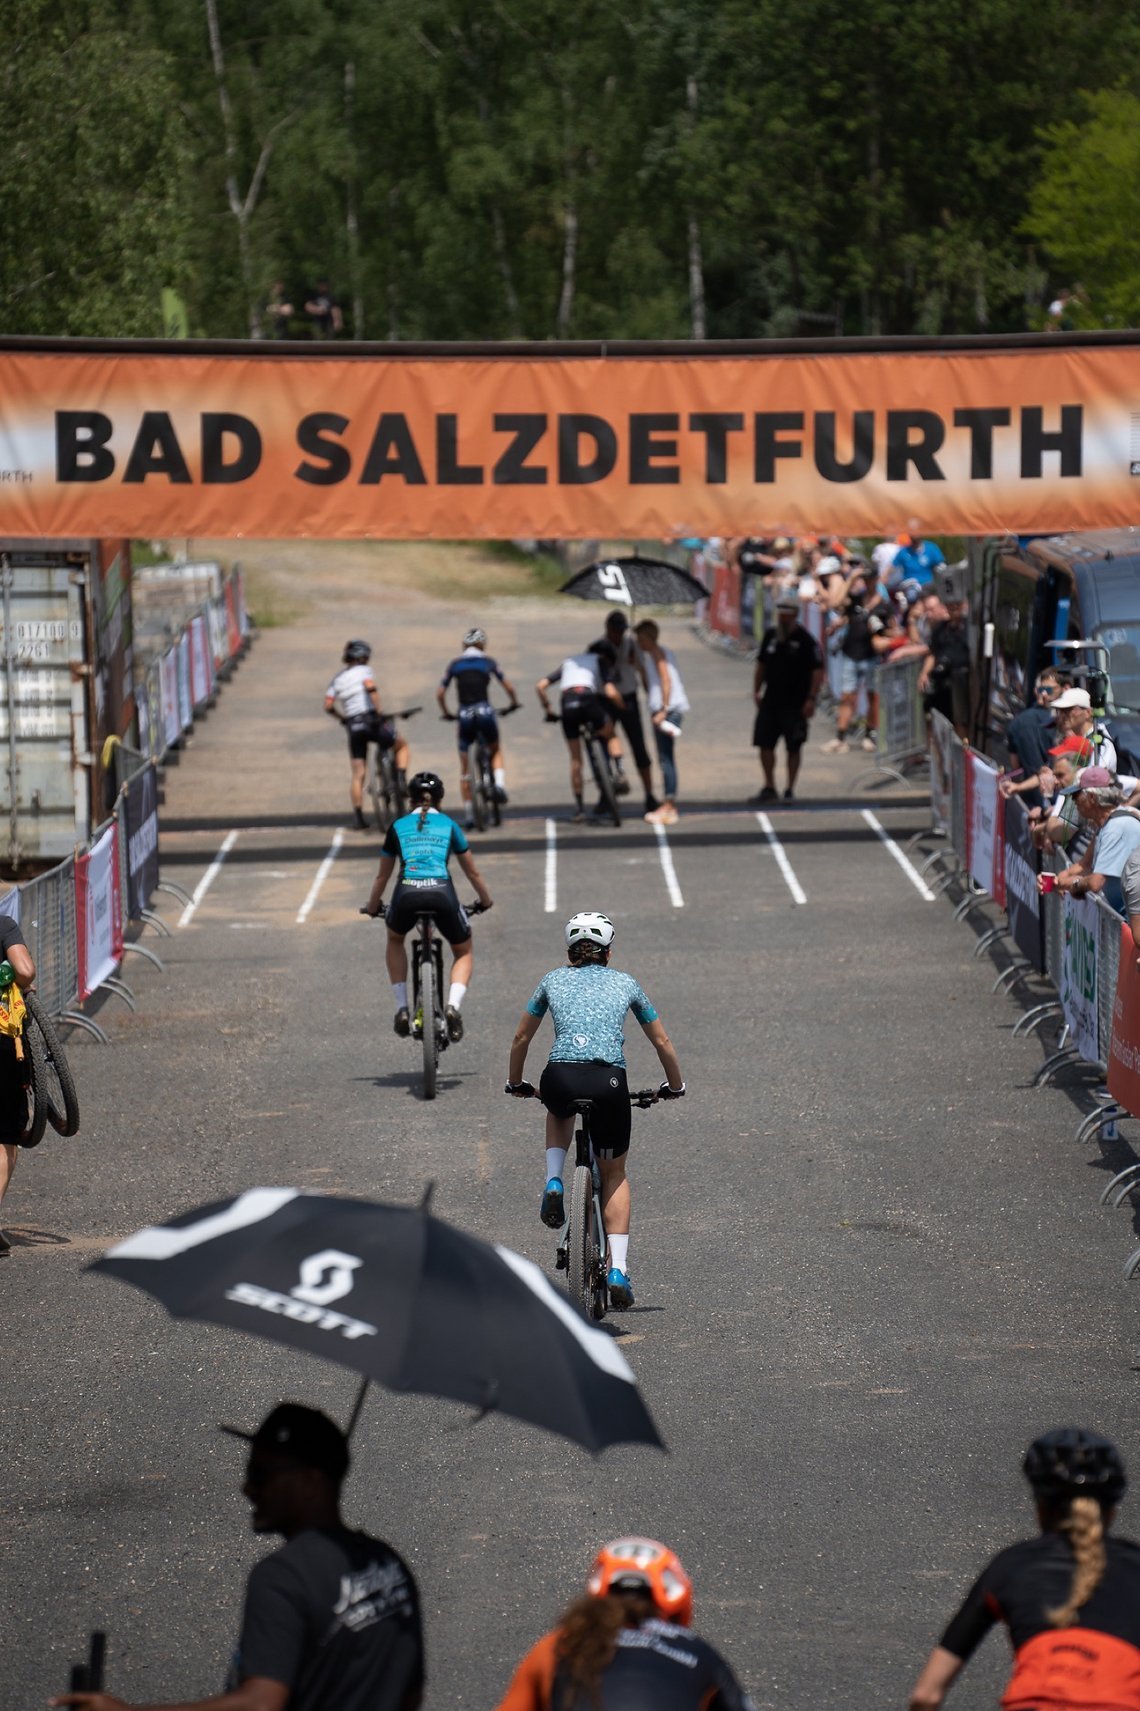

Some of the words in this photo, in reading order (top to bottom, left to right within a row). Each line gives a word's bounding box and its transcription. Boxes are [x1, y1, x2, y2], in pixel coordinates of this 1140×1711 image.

[55, 411, 262, 484] BAD
[295, 405, 1083, 486] SALZDETFURTH
[225, 1282, 379, 1340] SCOTT
